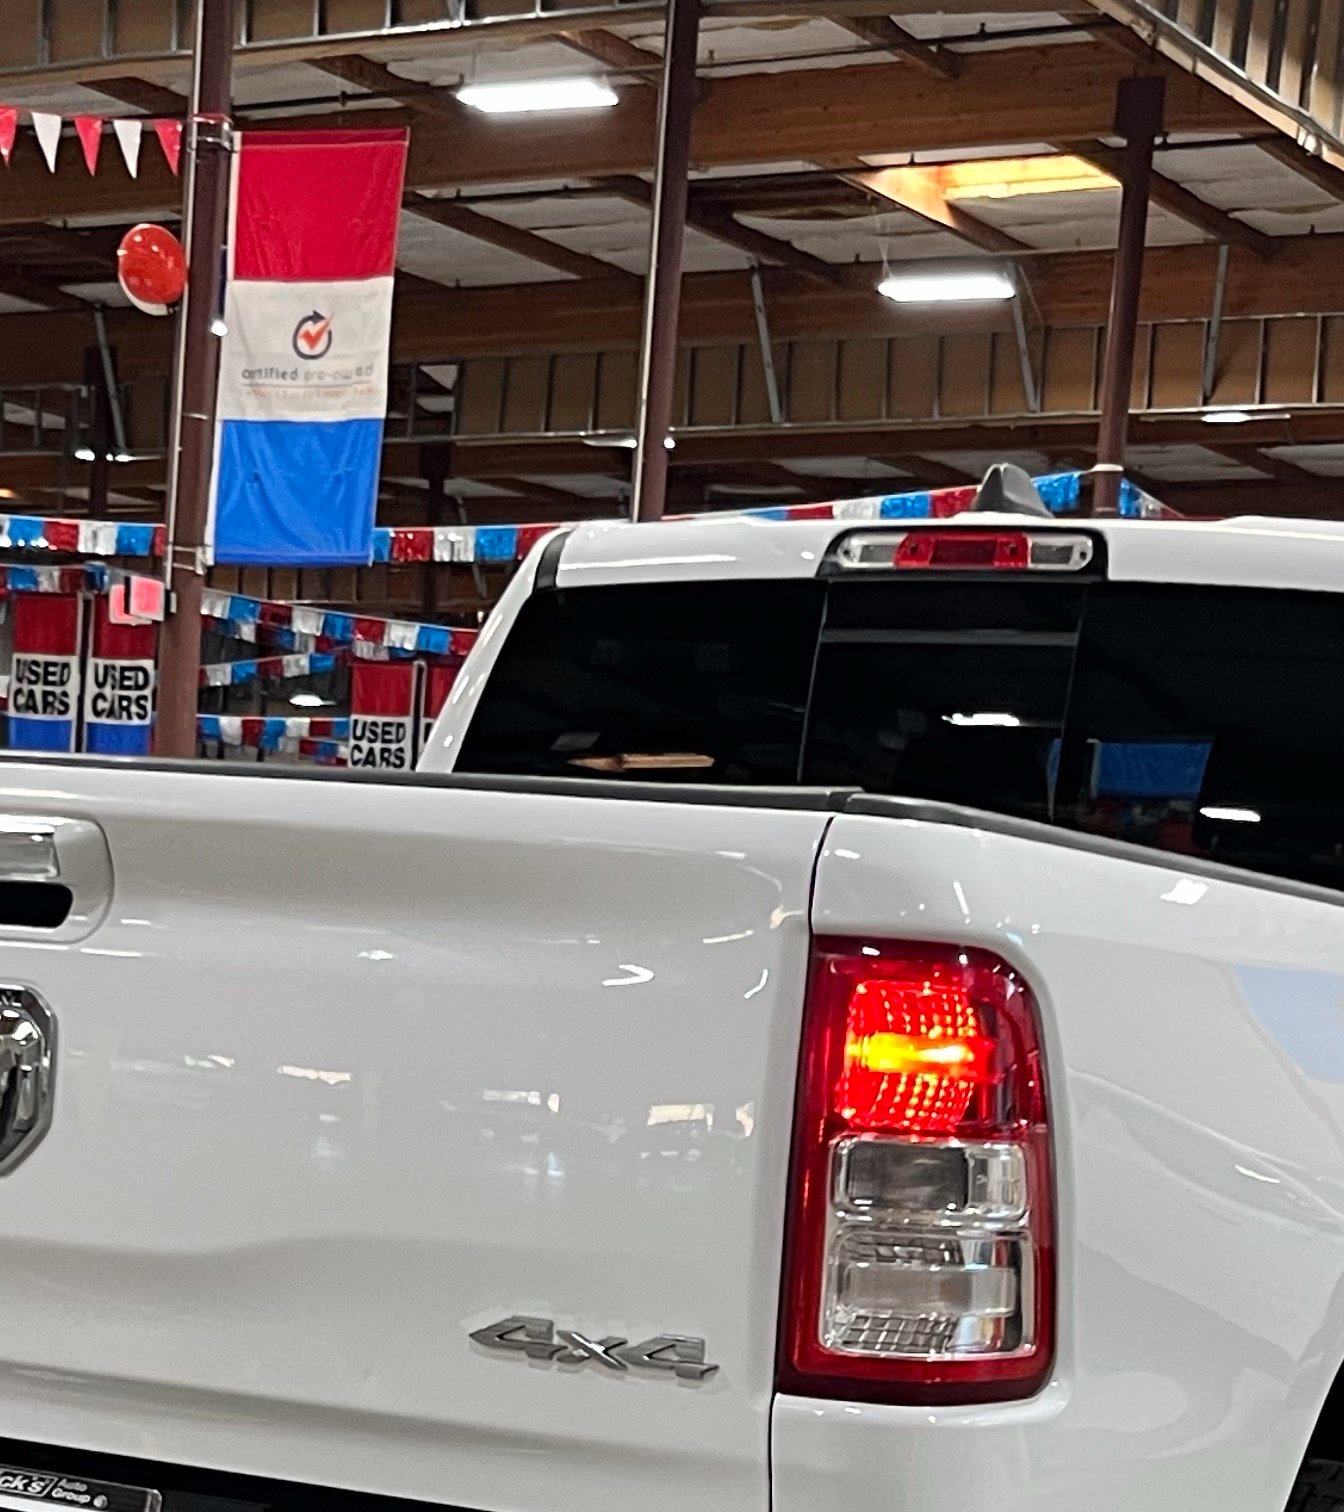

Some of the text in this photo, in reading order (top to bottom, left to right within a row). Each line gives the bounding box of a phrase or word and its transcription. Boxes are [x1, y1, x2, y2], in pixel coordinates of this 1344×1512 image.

[16, 659, 71, 686] USED
[94, 663, 149, 691] USED
[13, 687, 70, 715] CARS
[92, 692, 148, 720] CARS
[352, 719, 406, 744] USED
[351, 744, 405, 769] CARS
[56, 1478, 88, 1493] Auto
